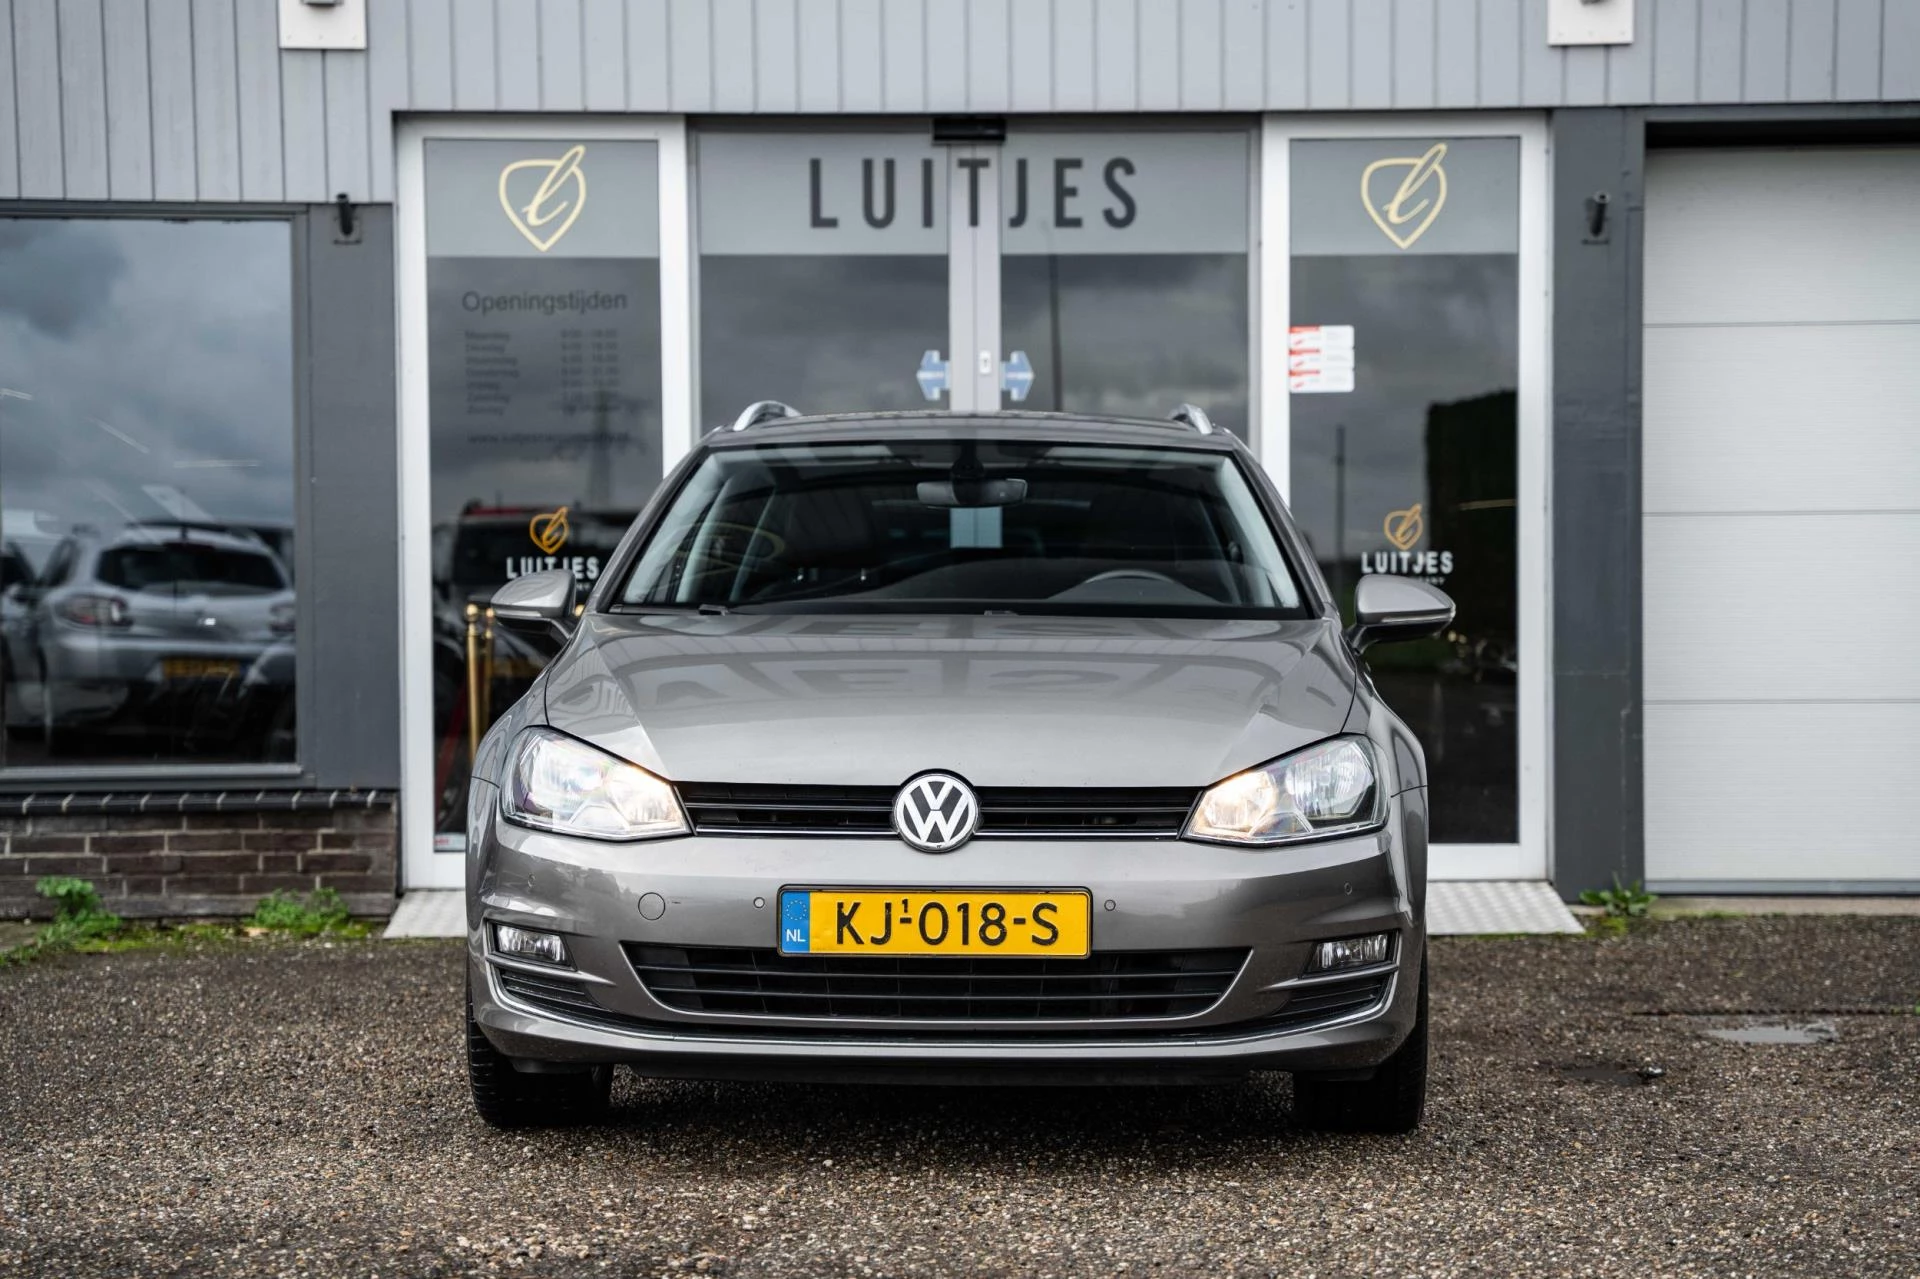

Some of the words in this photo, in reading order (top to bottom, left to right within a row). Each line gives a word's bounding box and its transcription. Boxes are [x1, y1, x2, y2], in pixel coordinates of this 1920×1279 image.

[810, 157, 1137, 229] LUITJES
[462, 290, 628, 316] Openingstijden
[1361, 551, 1453, 574] LUITJES
[786, 929, 806, 942] NL
